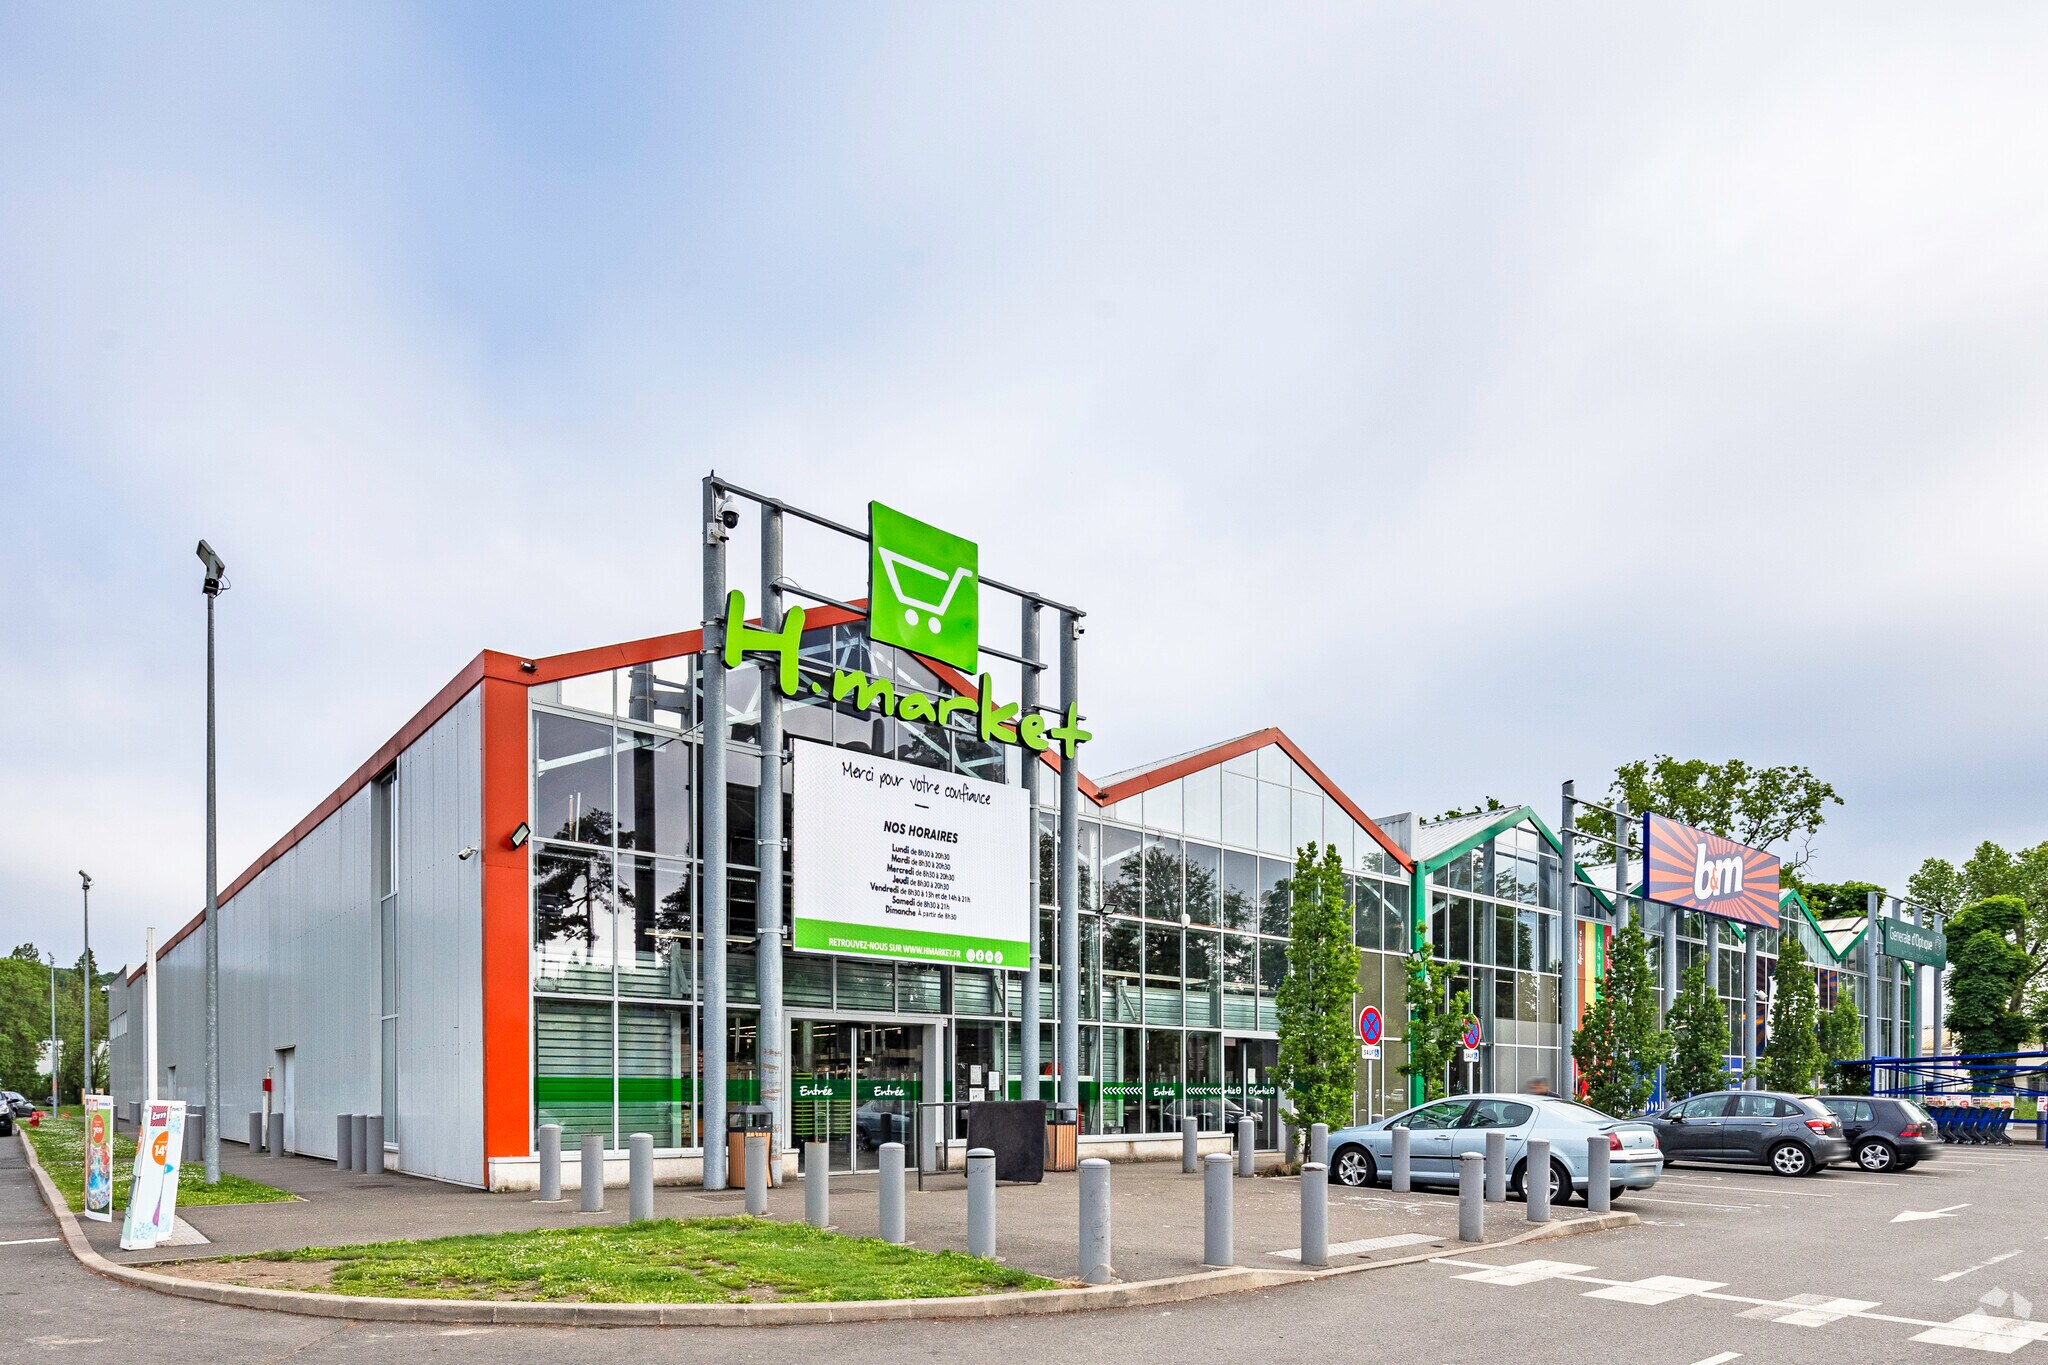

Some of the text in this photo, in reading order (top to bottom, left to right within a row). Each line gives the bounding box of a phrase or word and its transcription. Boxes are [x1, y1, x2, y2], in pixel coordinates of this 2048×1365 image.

[723, 590, 1092, 760] H.market
[842, 761, 991, 805] Merci pour votre confiance
[883, 820, 959, 844] NOS HORAIRES
[892, 843, 909, 854] Lundi
[918, 849, 930, 858] 8h30
[935, 851, 950, 860] 20h30
[891, 854, 910, 864] Mardi
[911, 858, 918, 866] de
[936, 862, 951, 871] 20h30
[887, 864, 914, 875] Mercredi
[915, 868, 922, 876] de
[939, 872, 955, 881] 20h30
[1694, 843, 1744, 900] b&m
[870, 882, 899, 893] Vendredi
[907, 888, 920, 897] 8h30
[892, 875, 909, 885] Jeudi
[934, 882, 949, 890] 20h30
[892, 895, 915, 906] Samedi
[885, 905, 916, 917] Dimanche
[922, 910, 936, 918] partir
[829, 937, 888, 951] RETROUVEZ-NOUS
[889, 943, 902, 953] SUR
[800, 1084, 834, 1096] Entrée
[873, 1084, 905, 1096] Entrée
[1153, 1086, 1175, 1097] Entrée
